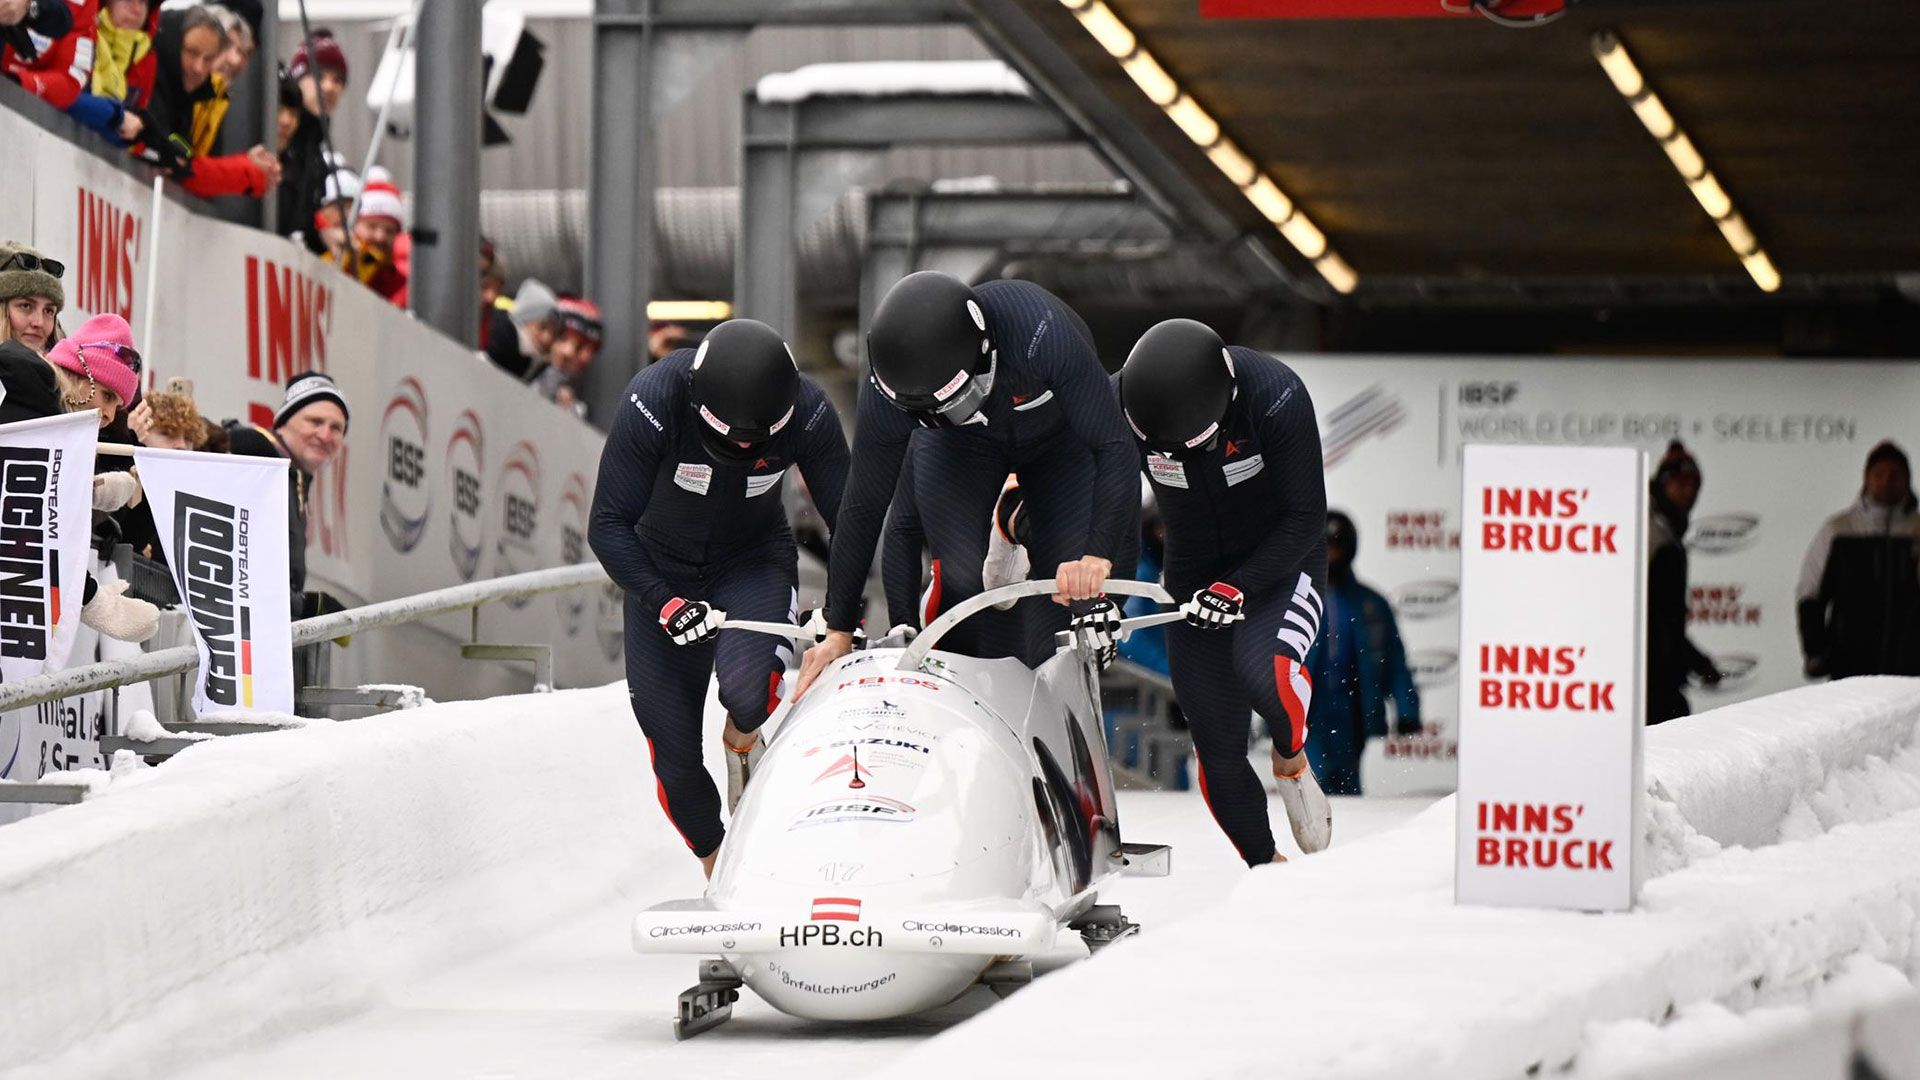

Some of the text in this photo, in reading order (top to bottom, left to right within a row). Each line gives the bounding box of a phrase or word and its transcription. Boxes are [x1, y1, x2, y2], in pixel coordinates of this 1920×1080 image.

[77, 187, 142, 322] INNS'
[245, 255, 333, 384] INNS'
[635, 400, 663, 431] SUZUKI
[1458, 413, 1554, 441] WORLD
[1561, 413, 1615, 441] CUP
[1712, 413, 1857, 443] SKELETON
[48, 449, 62, 539] BOBTEAM
[1482, 486, 1588, 517] INNS'
[1482, 522, 1617, 553] BRUCK
[238, 508, 250, 599] BOBTEAM
[173, 490, 237, 706] LOCHNER
[1203, 594, 1231, 612] SEIZ
[675, 607, 700, 631] SEIZ
[1277, 571, 1323, 664] AUT
[1479, 645, 1585, 675] INNS'
[1479, 679, 1615, 711] BRUCK
[830, 738, 930, 755] SUZUKI
[806, 804, 898, 818] IBSF
[1478, 802, 1584, 832] INNS'
[1477, 838, 1614, 869] BRUCK
[780, 924, 883, 947] HPB.ch
